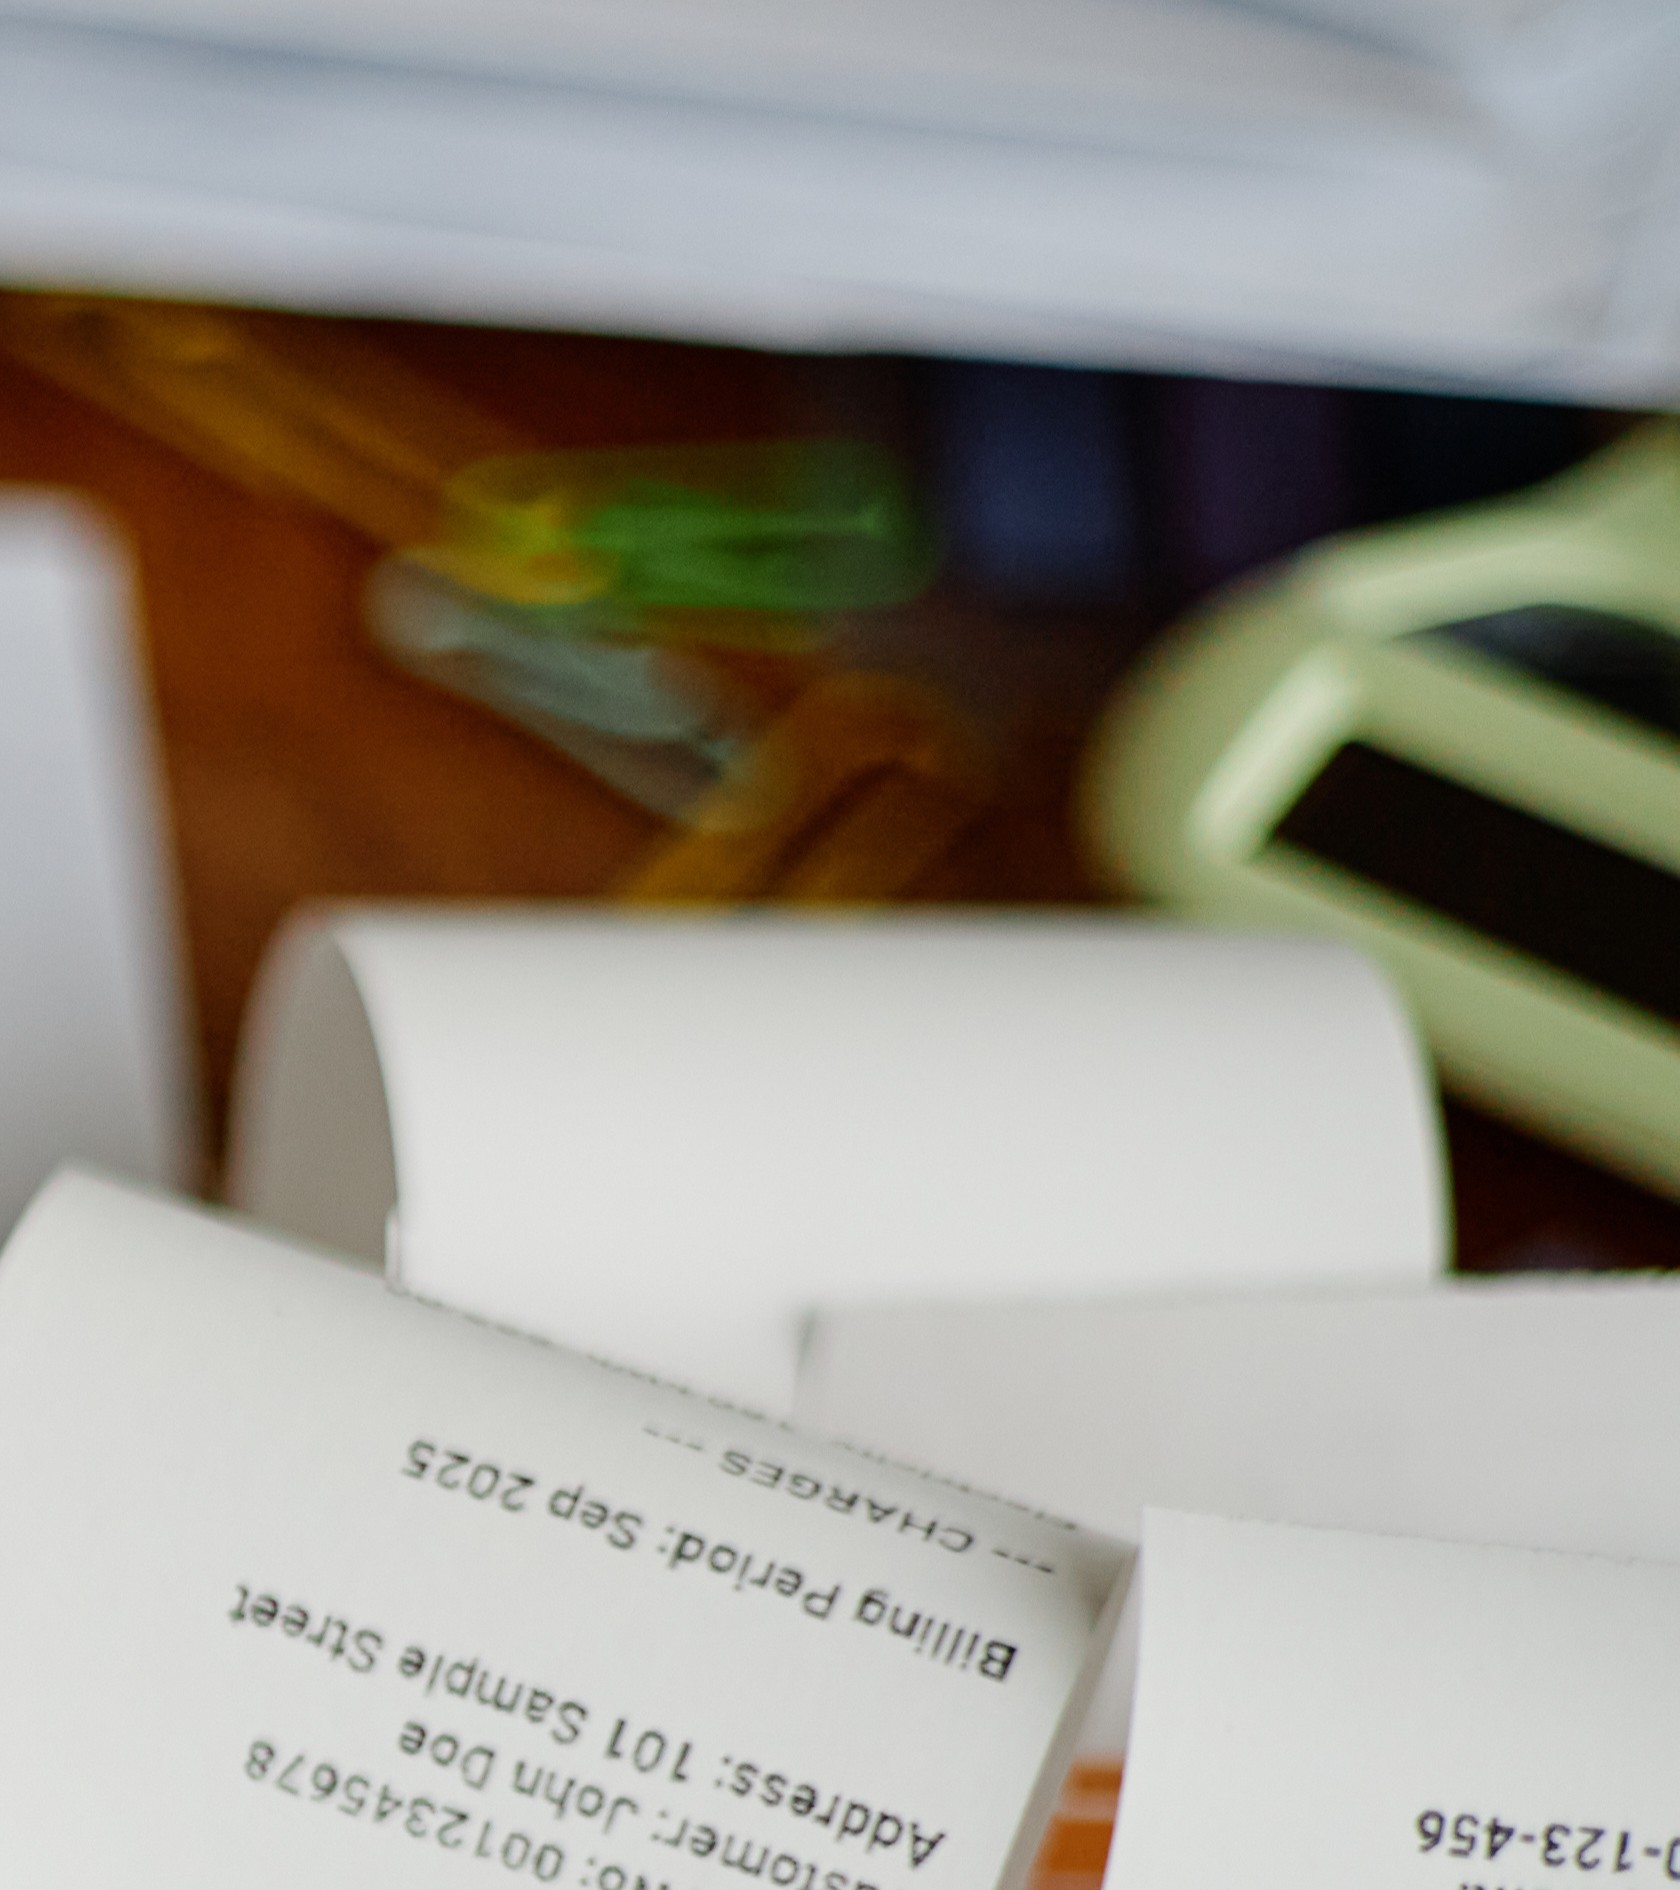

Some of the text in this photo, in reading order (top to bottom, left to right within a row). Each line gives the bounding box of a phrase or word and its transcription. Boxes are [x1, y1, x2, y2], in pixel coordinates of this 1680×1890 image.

[400, 1436, 536, 1515] 2025
[547, 1484, 646, 1554] Sep
[718, 1450, 977, 1557] CHARGES
[658, 1523, 842, 1623] Period:
[856, 1590, 1021, 1683] Billing
[228, 1582, 947, 1871] Address: 101 Sample Street
[397, 1719, 499, 1791] Doe
[243, 1738, 566, 1885] 0012345678
[512, 1762, 644, 1833] John
